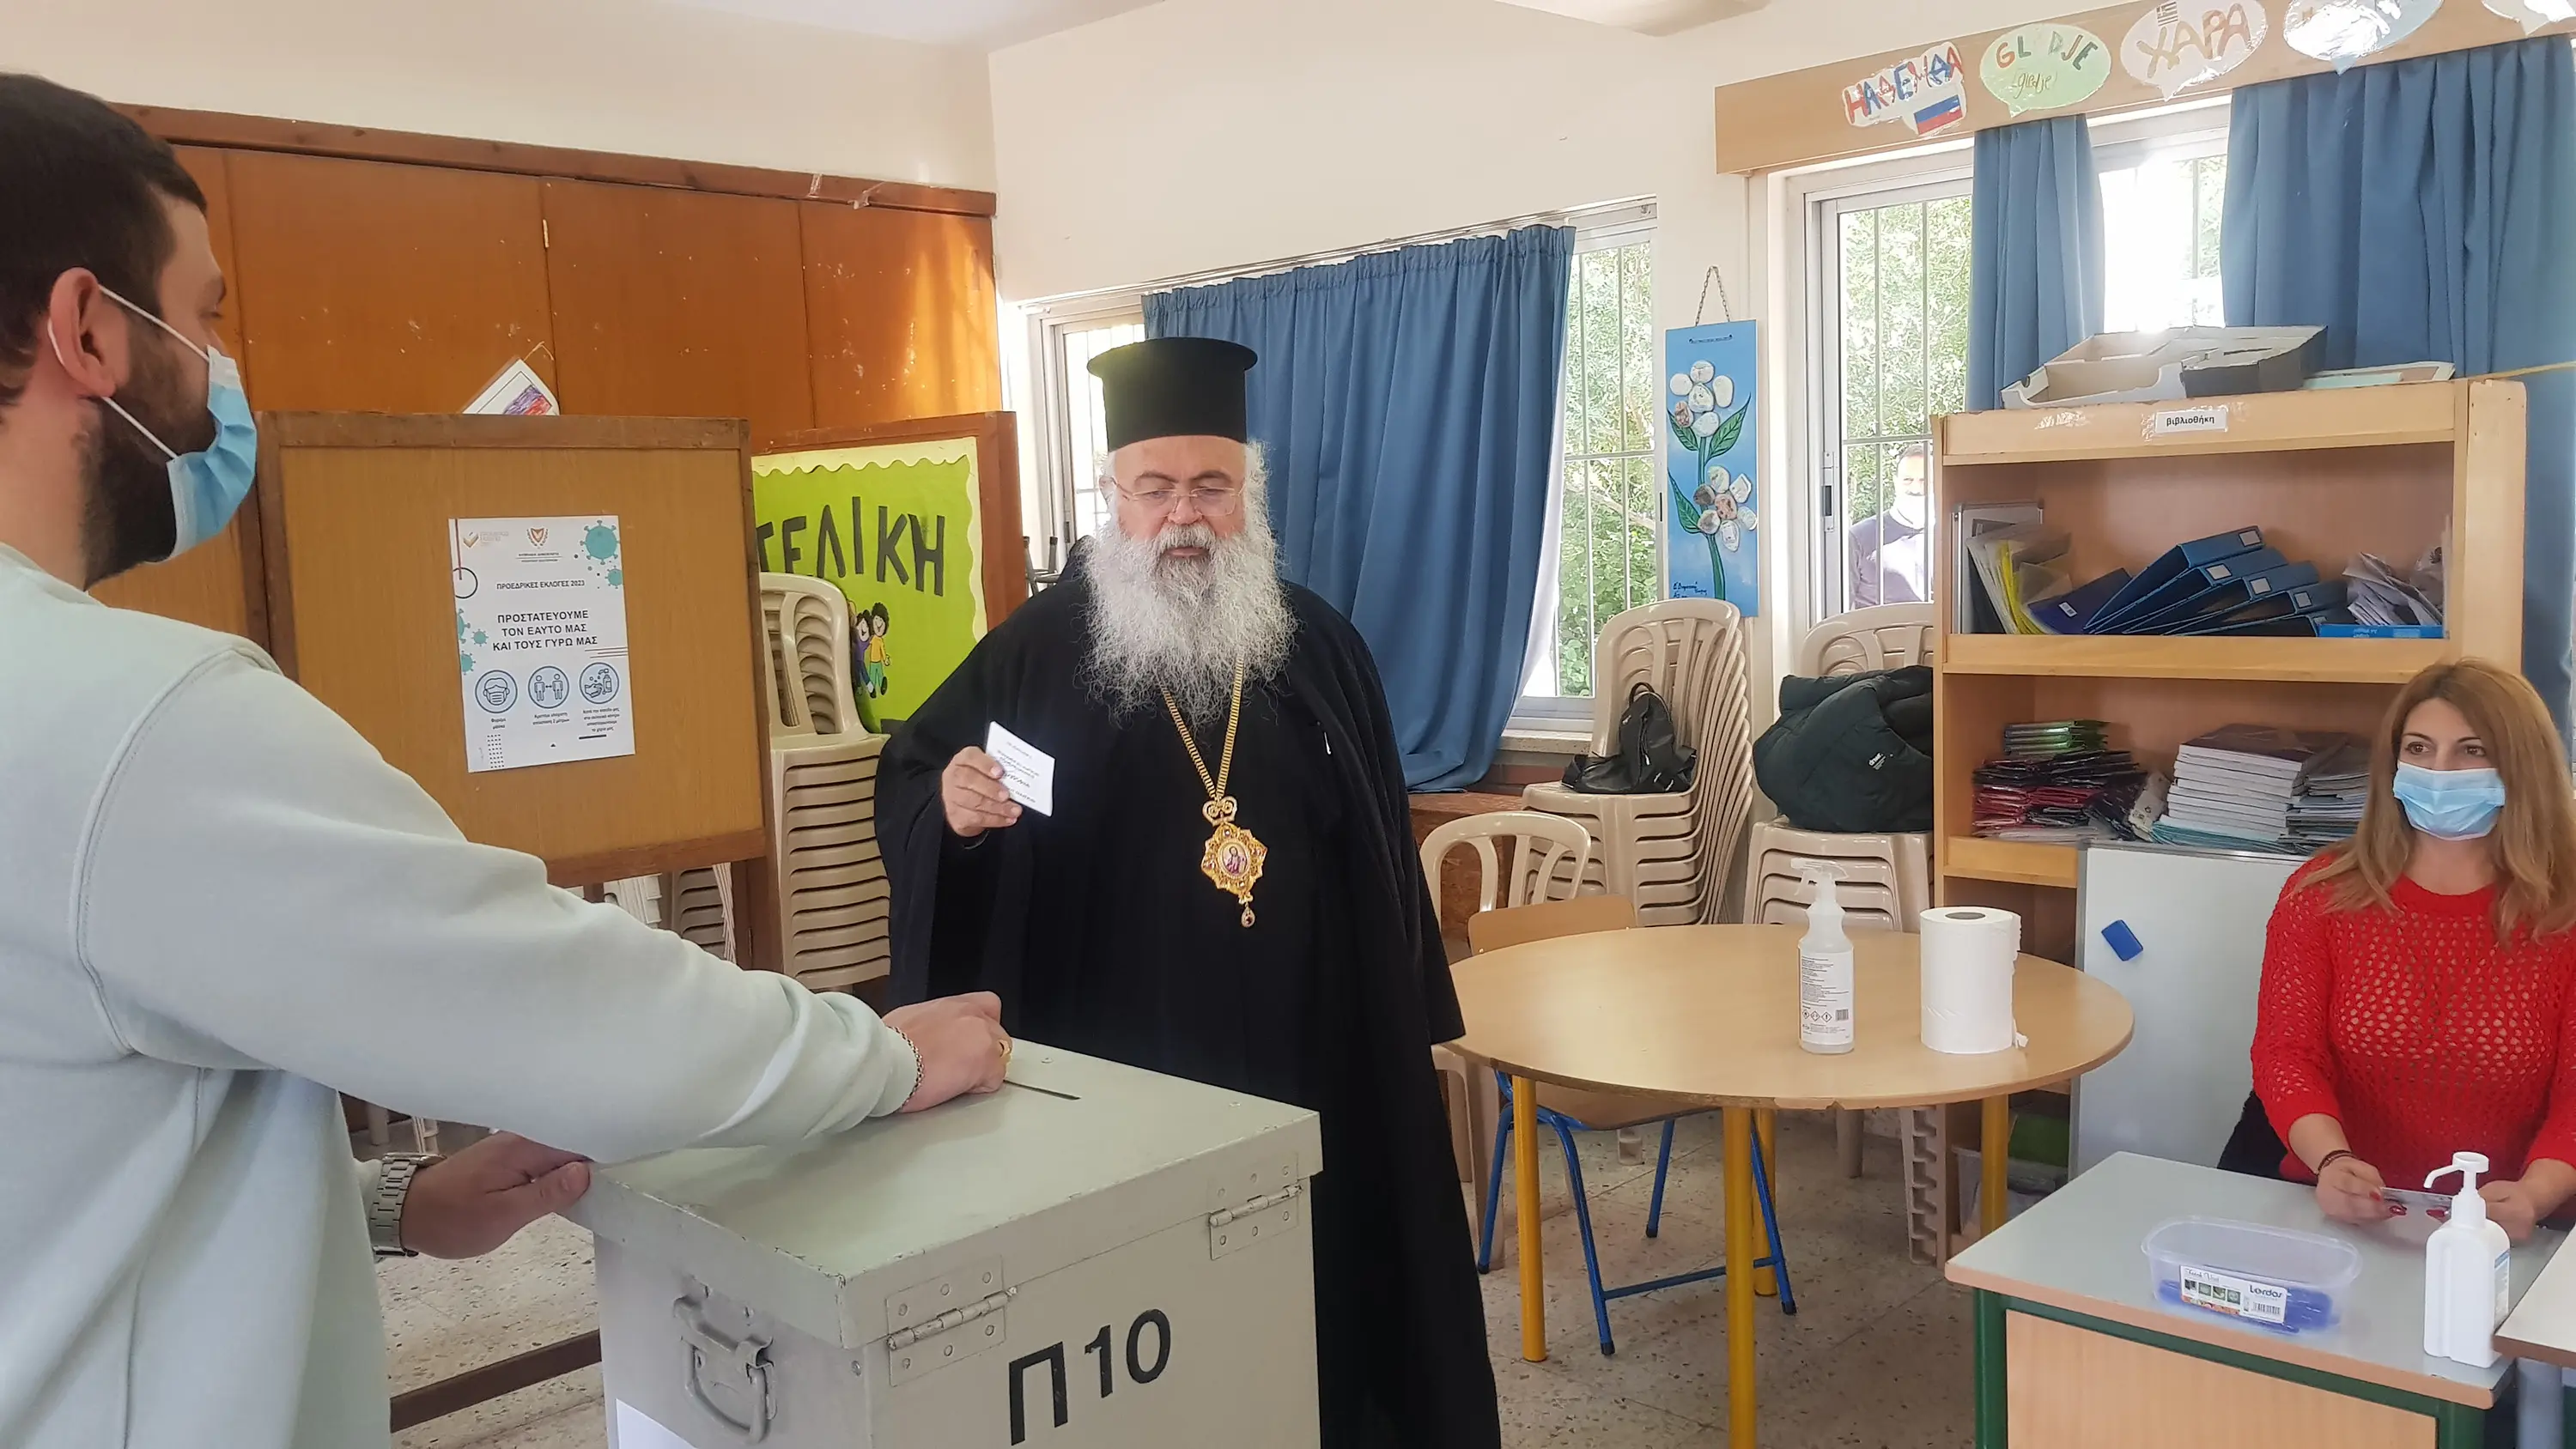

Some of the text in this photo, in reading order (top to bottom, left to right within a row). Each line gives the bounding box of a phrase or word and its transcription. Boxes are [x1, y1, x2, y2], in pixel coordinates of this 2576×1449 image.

[2136, 3, 2253, 78] ΧΑΡΑ
[2166, 415, 2215, 427] βιβλιοθήκη
[496, 581, 539, 590] ΠΡΟΕΔΡΙΚΕΣ
[497, 610, 589, 623] ΠΡΟΣΤΑΤΕΥΟΥΜΕ
[501, 623, 587, 637] ΤΟΝ ΕΑΥΤΟ ΜΑΣ
[493, 636, 598, 652] ΚΑΙ ΤΟΥΣ ΓΥΡΩ ΜΑΣ
[2250, 1285, 2282, 1299] Lordos
